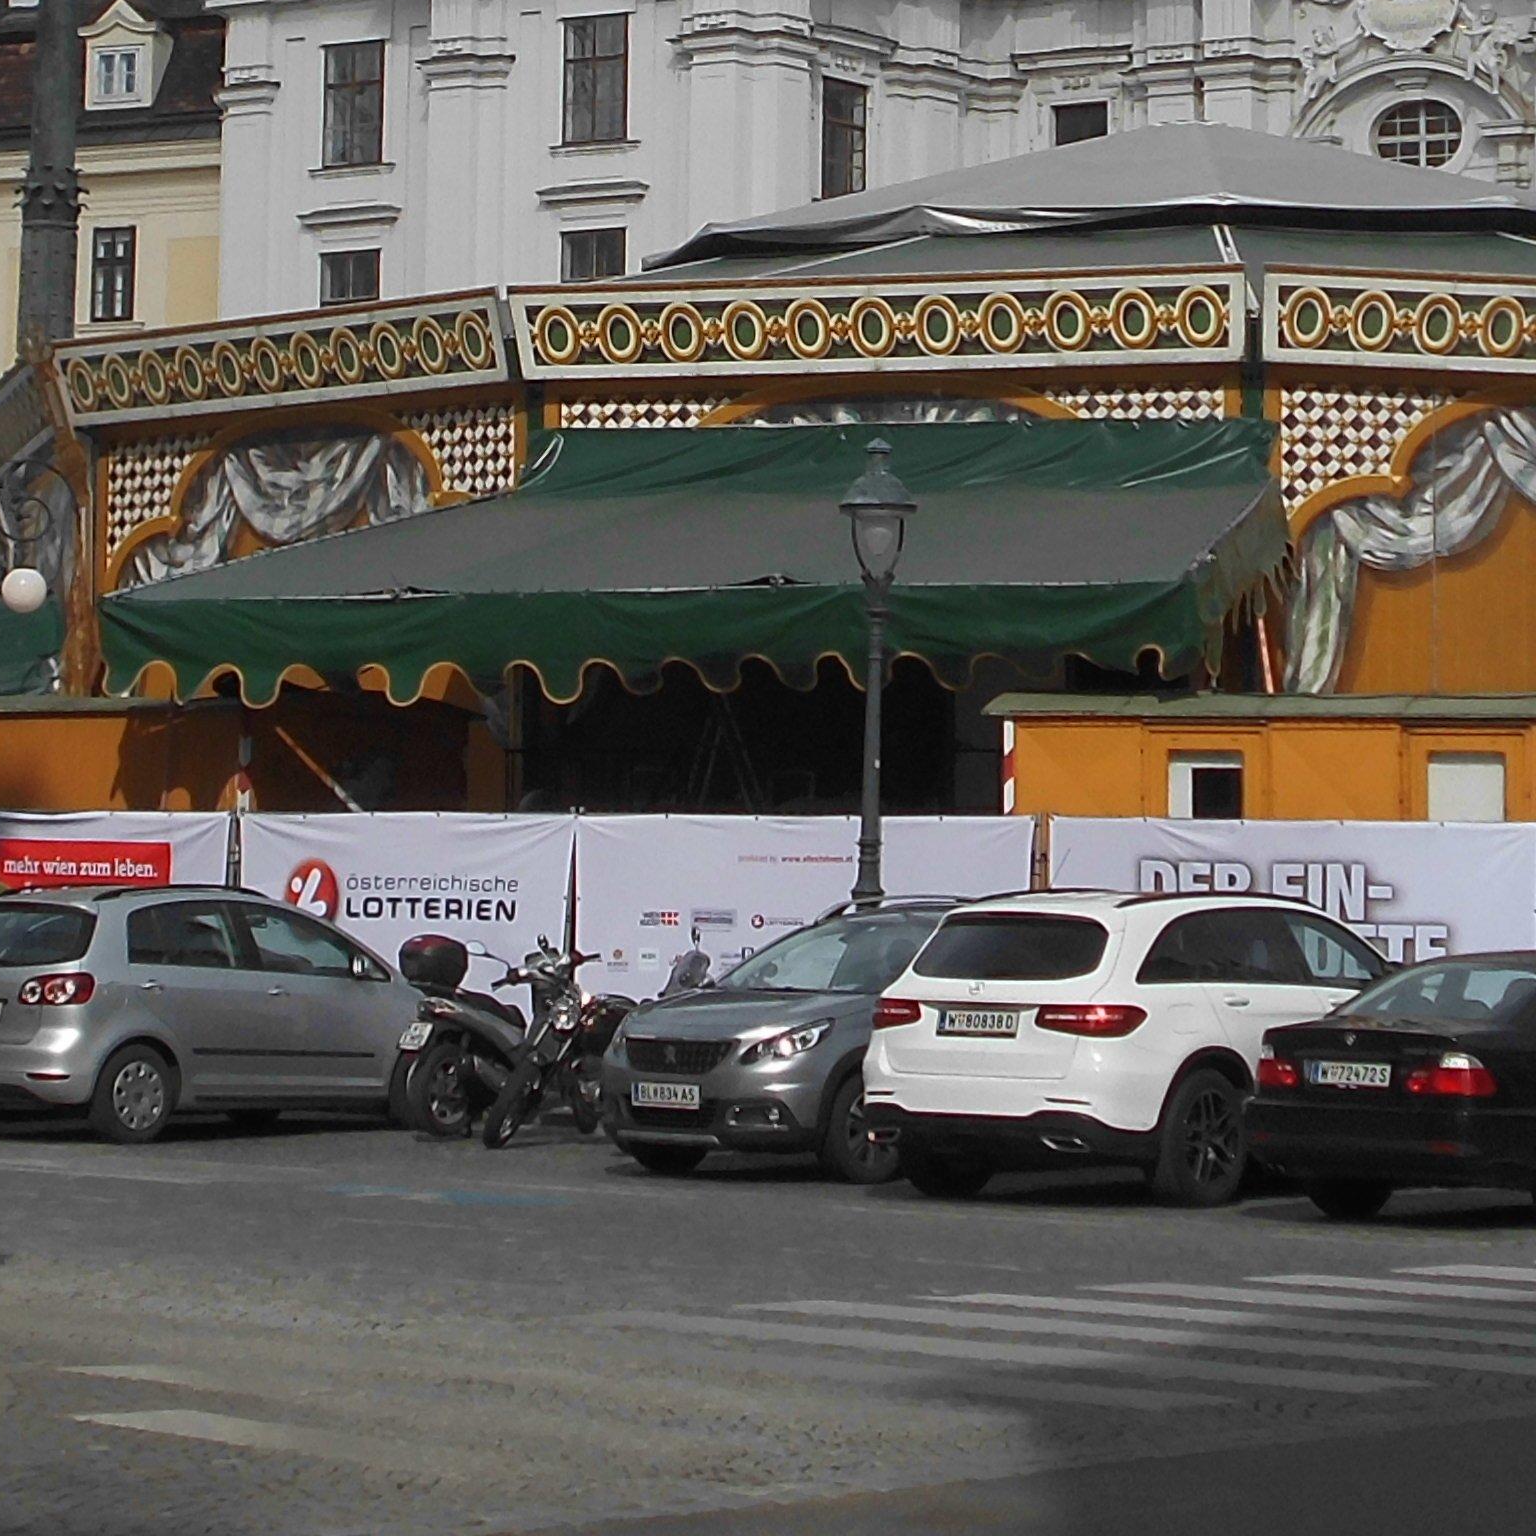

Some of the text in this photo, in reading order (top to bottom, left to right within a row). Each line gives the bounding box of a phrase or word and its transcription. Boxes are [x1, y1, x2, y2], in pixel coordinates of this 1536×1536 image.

[3, 856, 158, 878] mehr wien zum leben.
[346, 873, 520, 893] österreichische
[345, 897, 518, 922] LOTTERIEN
